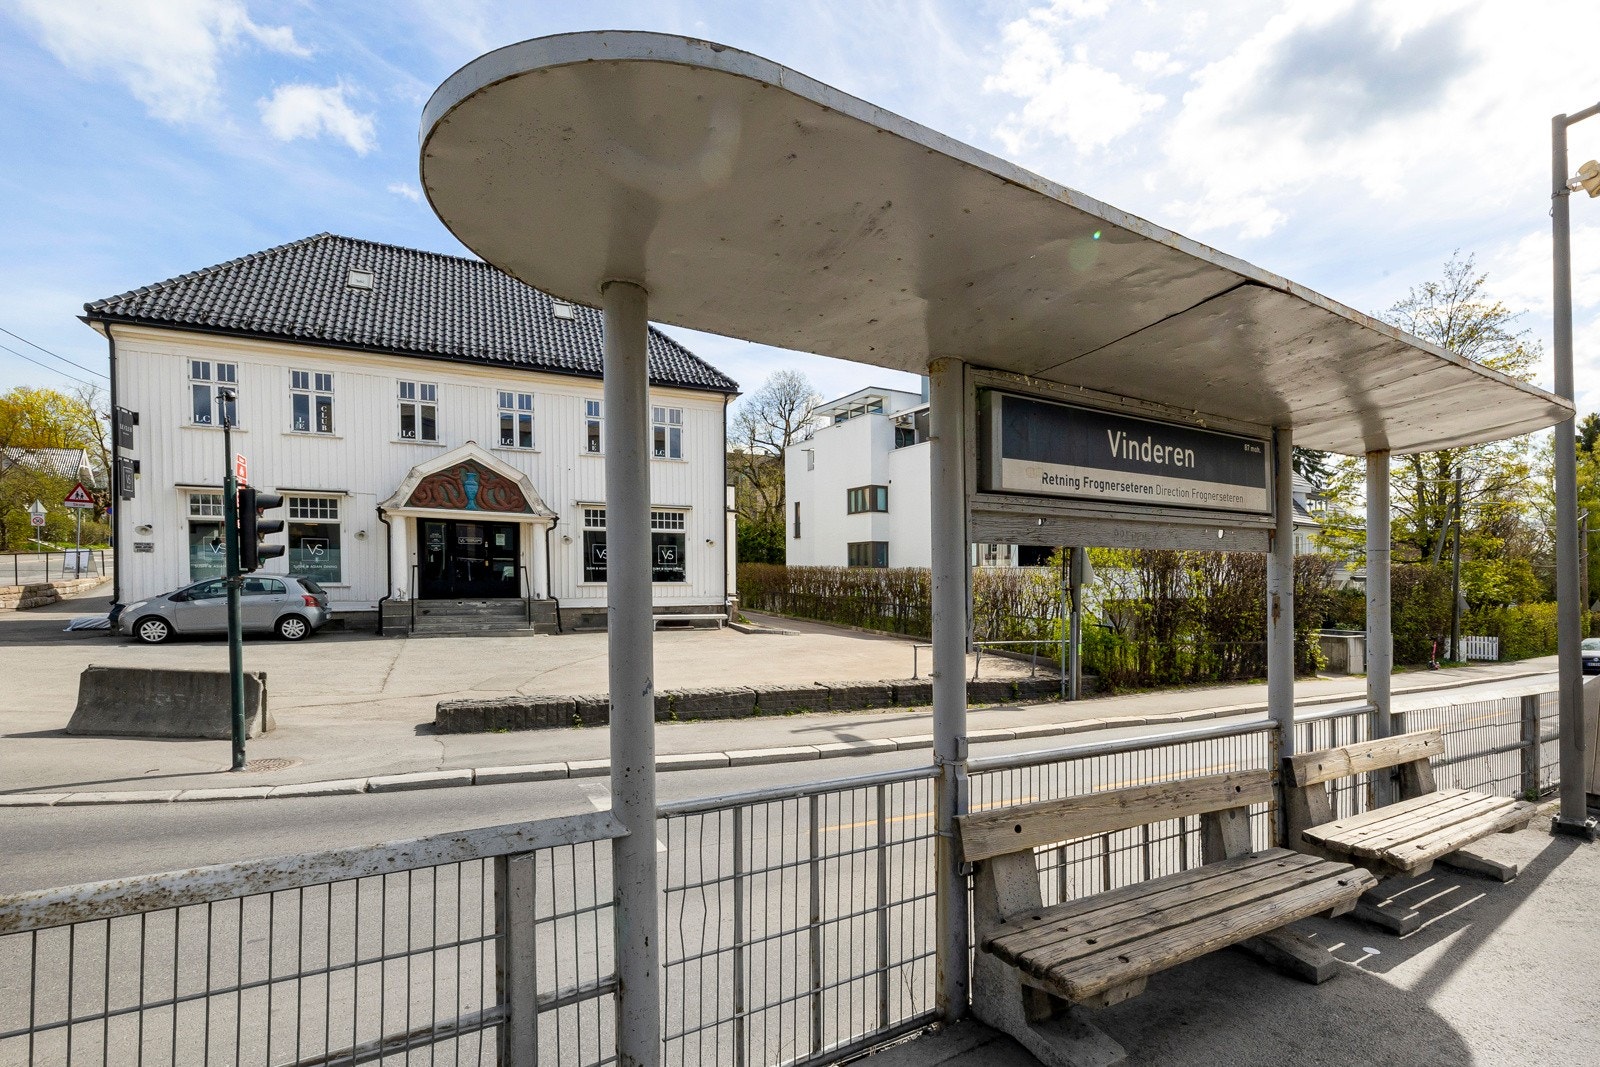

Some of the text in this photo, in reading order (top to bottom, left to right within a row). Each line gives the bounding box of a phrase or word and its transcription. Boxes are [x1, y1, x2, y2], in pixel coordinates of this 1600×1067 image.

[195, 414, 211, 423] LC
[402, 429, 415, 438] LC
[502, 437, 513, 445] LC
[1107, 429, 1195, 468] Vinderen
[1042, 472, 1244, 503] Retning Frognerseteren Direction Frognerseteren
[306, 543, 324, 556] VS
[661, 549, 674, 560] VS
